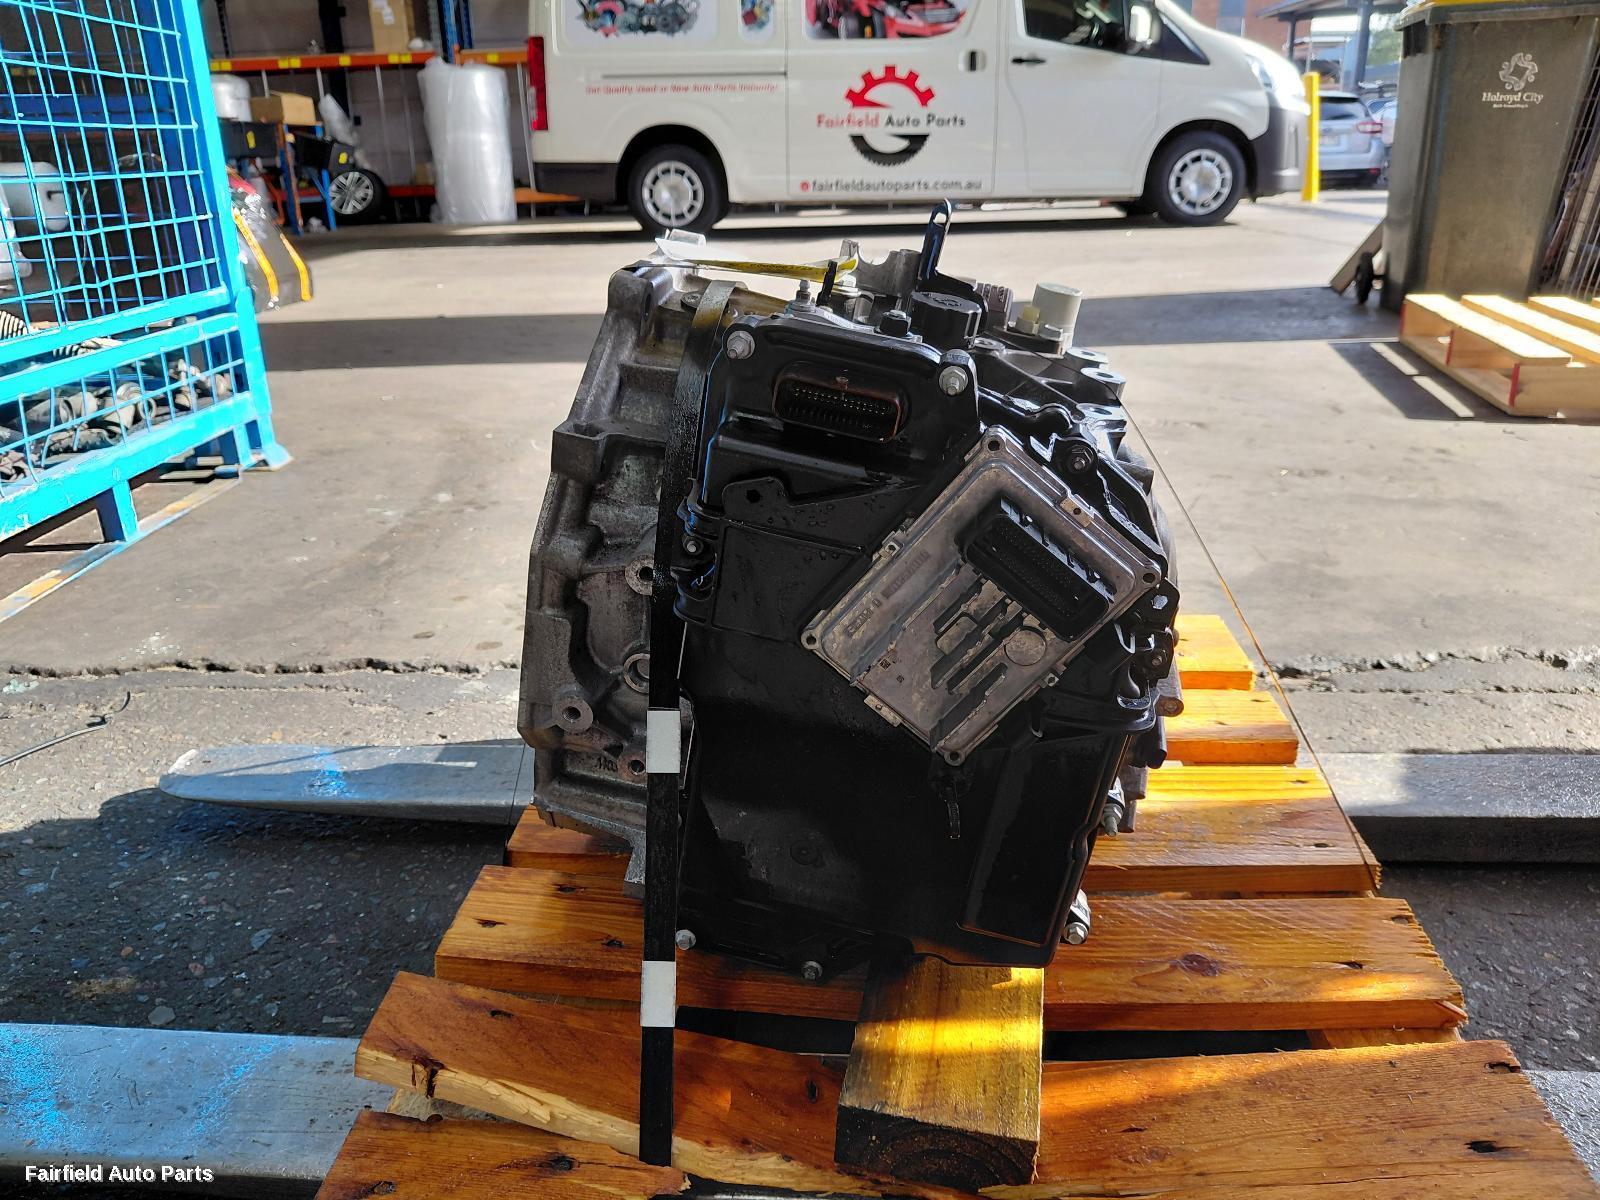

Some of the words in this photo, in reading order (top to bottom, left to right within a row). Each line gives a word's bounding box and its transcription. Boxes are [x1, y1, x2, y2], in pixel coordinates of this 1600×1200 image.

[1482, 92, 1521, 104] Holroyd
[1522, 92, 1544, 104] City
[816, 114, 879, 128] Fairfield
[884, 114, 920, 128] Auto
[926, 113, 967, 127] Parts
[812, 180, 982, 194] fairfieldautoparts.com.au
